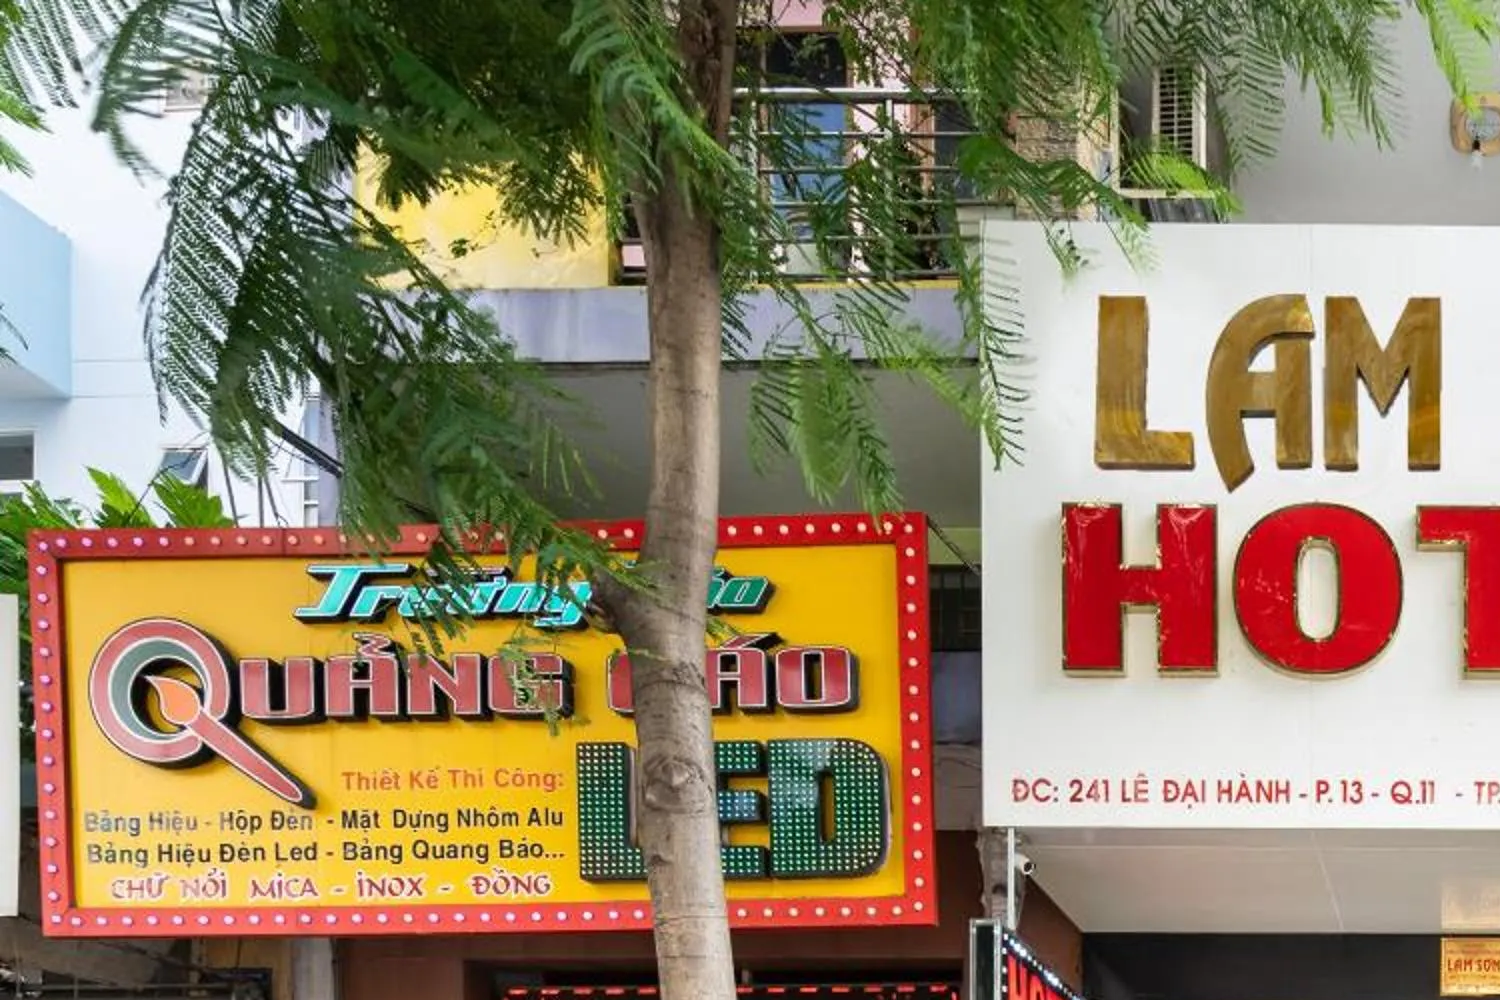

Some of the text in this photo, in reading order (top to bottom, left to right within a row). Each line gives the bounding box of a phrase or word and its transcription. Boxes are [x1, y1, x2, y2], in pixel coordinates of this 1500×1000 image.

[1093, 292, 1443, 494] LAM
[341, 765, 566, 792] Thiết Kế Thi Công:
[1011, 778, 1059, 803] ĐC:
[1069, 779, 1110, 803] 241
[1121, 773, 1150, 803] LÊ
[1162, 778, 1206, 810] ĐẠI
[1217, 772, 1291, 803] HÀNH
[84, 809, 141, 836] Bảng
[148, 809, 198, 834] Hiệu
[219, 809, 262, 834] Hộp
[270, 806, 314, 830] Đèn
[393, 806, 449, 833] Dựng
[457, 804, 521, 829] Nhôm
[526, 806, 564, 827] Alu
[87, 841, 148, 867] Bảng
[157, 840, 212, 866] Hiệu
[218, 840, 266, 863] Đèn
[274, 839, 318, 862] Led
[343, 838, 403, 865] Bảng
[411, 837, 489, 863] Quang
